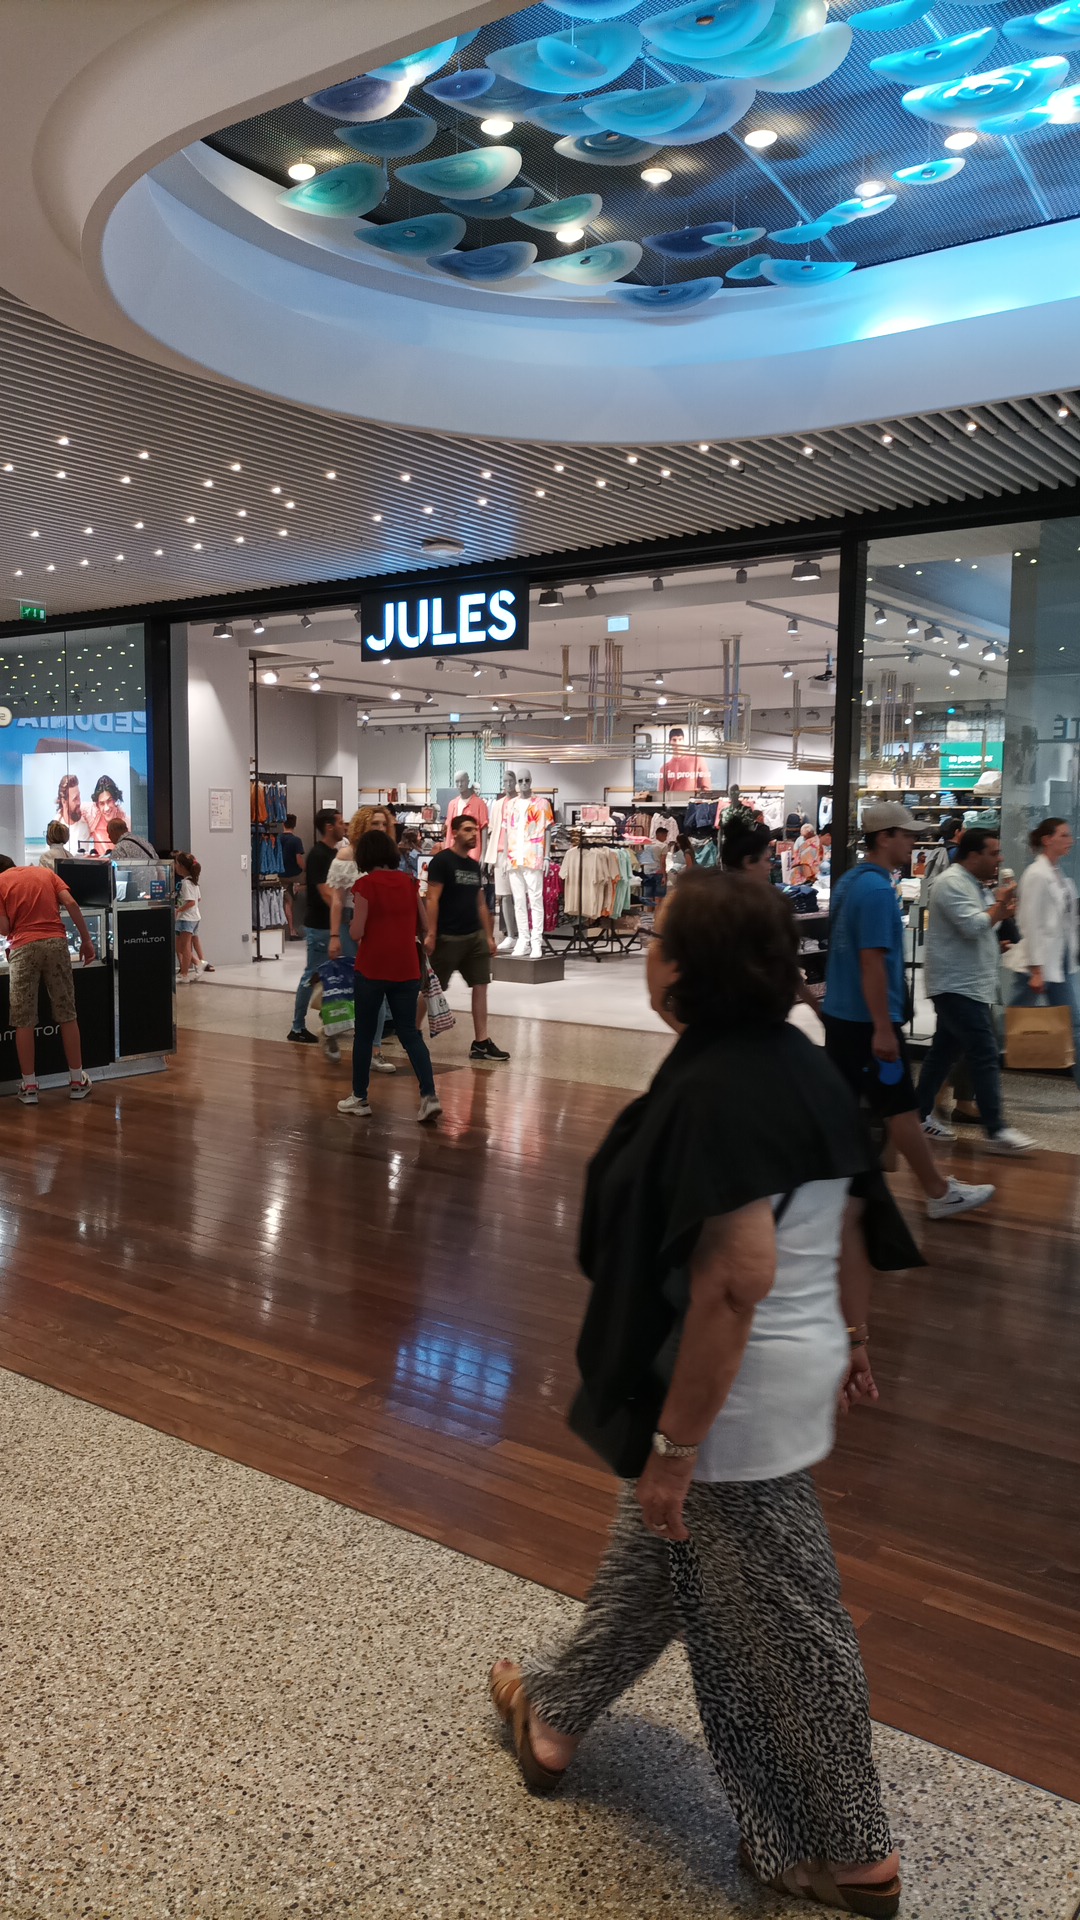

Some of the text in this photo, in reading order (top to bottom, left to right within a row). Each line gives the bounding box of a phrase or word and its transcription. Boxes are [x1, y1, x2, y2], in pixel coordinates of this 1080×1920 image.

[366, 590, 516, 651] JULES
[668, 770, 675, 778] in
[123, 936, 166, 944] HAMILTON
